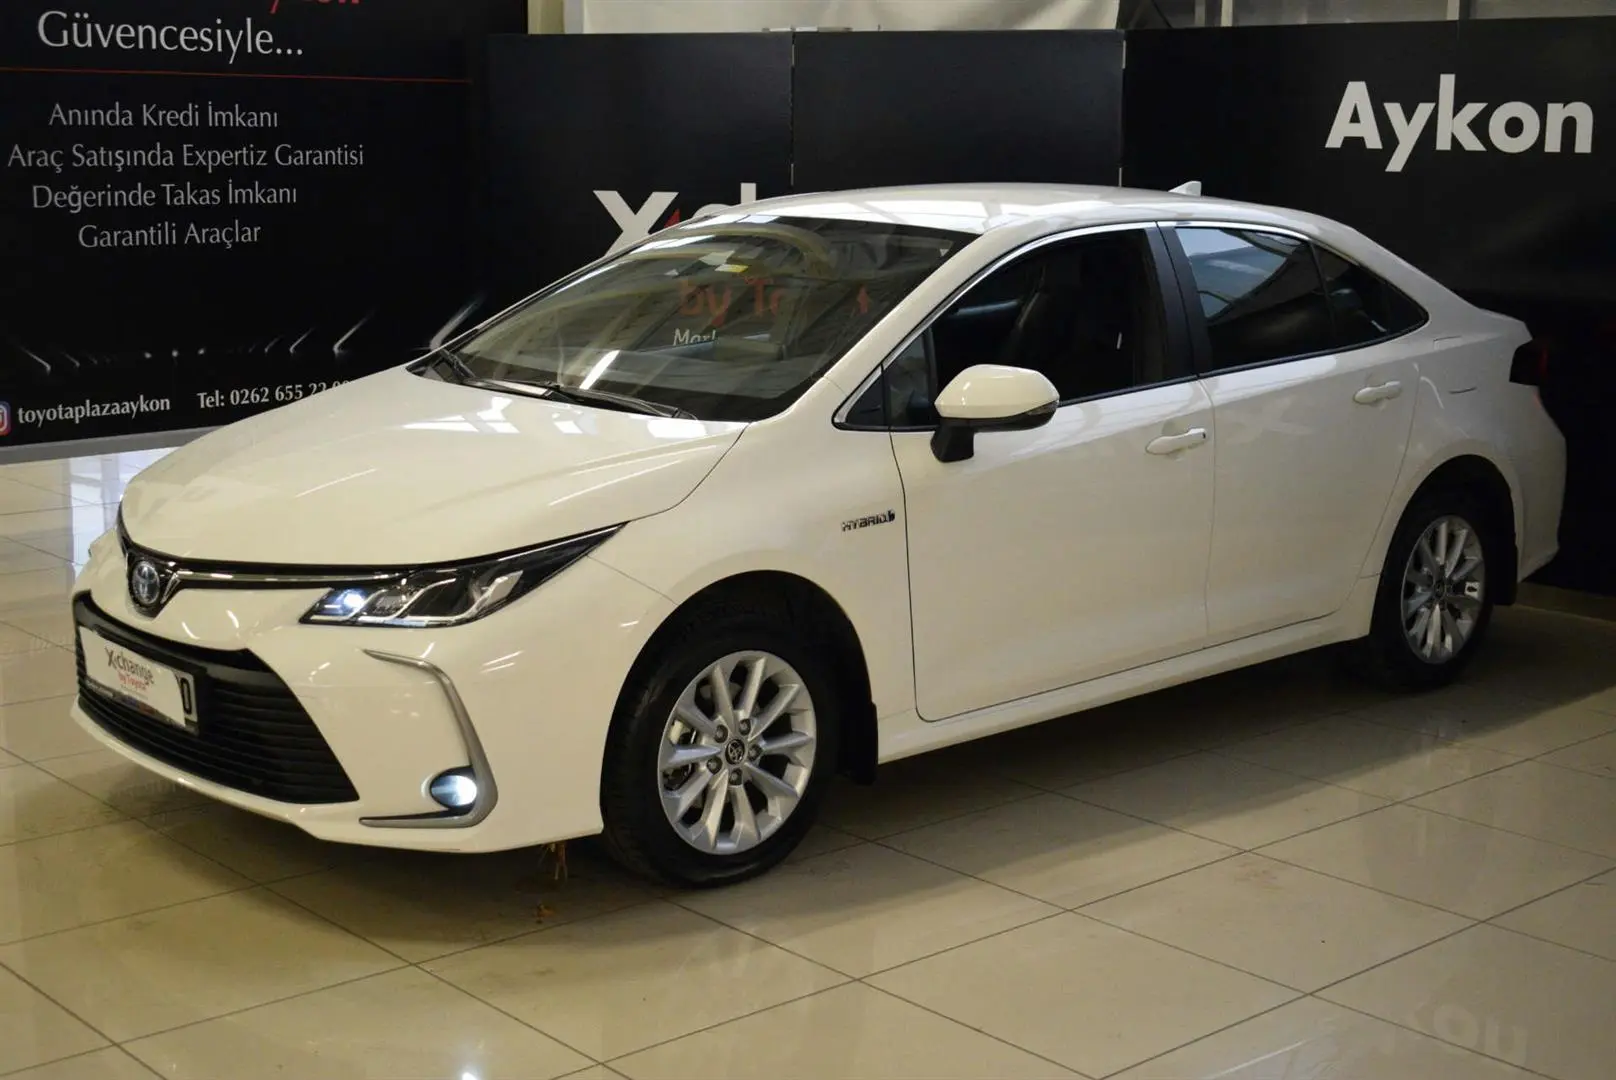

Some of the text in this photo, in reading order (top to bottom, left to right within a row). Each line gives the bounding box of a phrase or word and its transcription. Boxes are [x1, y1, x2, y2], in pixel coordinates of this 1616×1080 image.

[37, 10, 303, 64] Güvencesiyle...
[49, 101, 278, 128] Anında Kredi İmkanı
[1324, 73, 1594, 173] Aykon
[7, 142, 364, 173] Araç Satışında Expertiz Garantisi
[32, 179, 297, 214] Değerinde Takas İmkanı
[78, 220, 261, 249] Garantili Araçlar
[17, 395, 171, 428] toyotaplazaaykon
[197, 391, 225, 409] Tel:
[230, 387, 269, 406] 0262
[274, 384, 303, 402] 655
